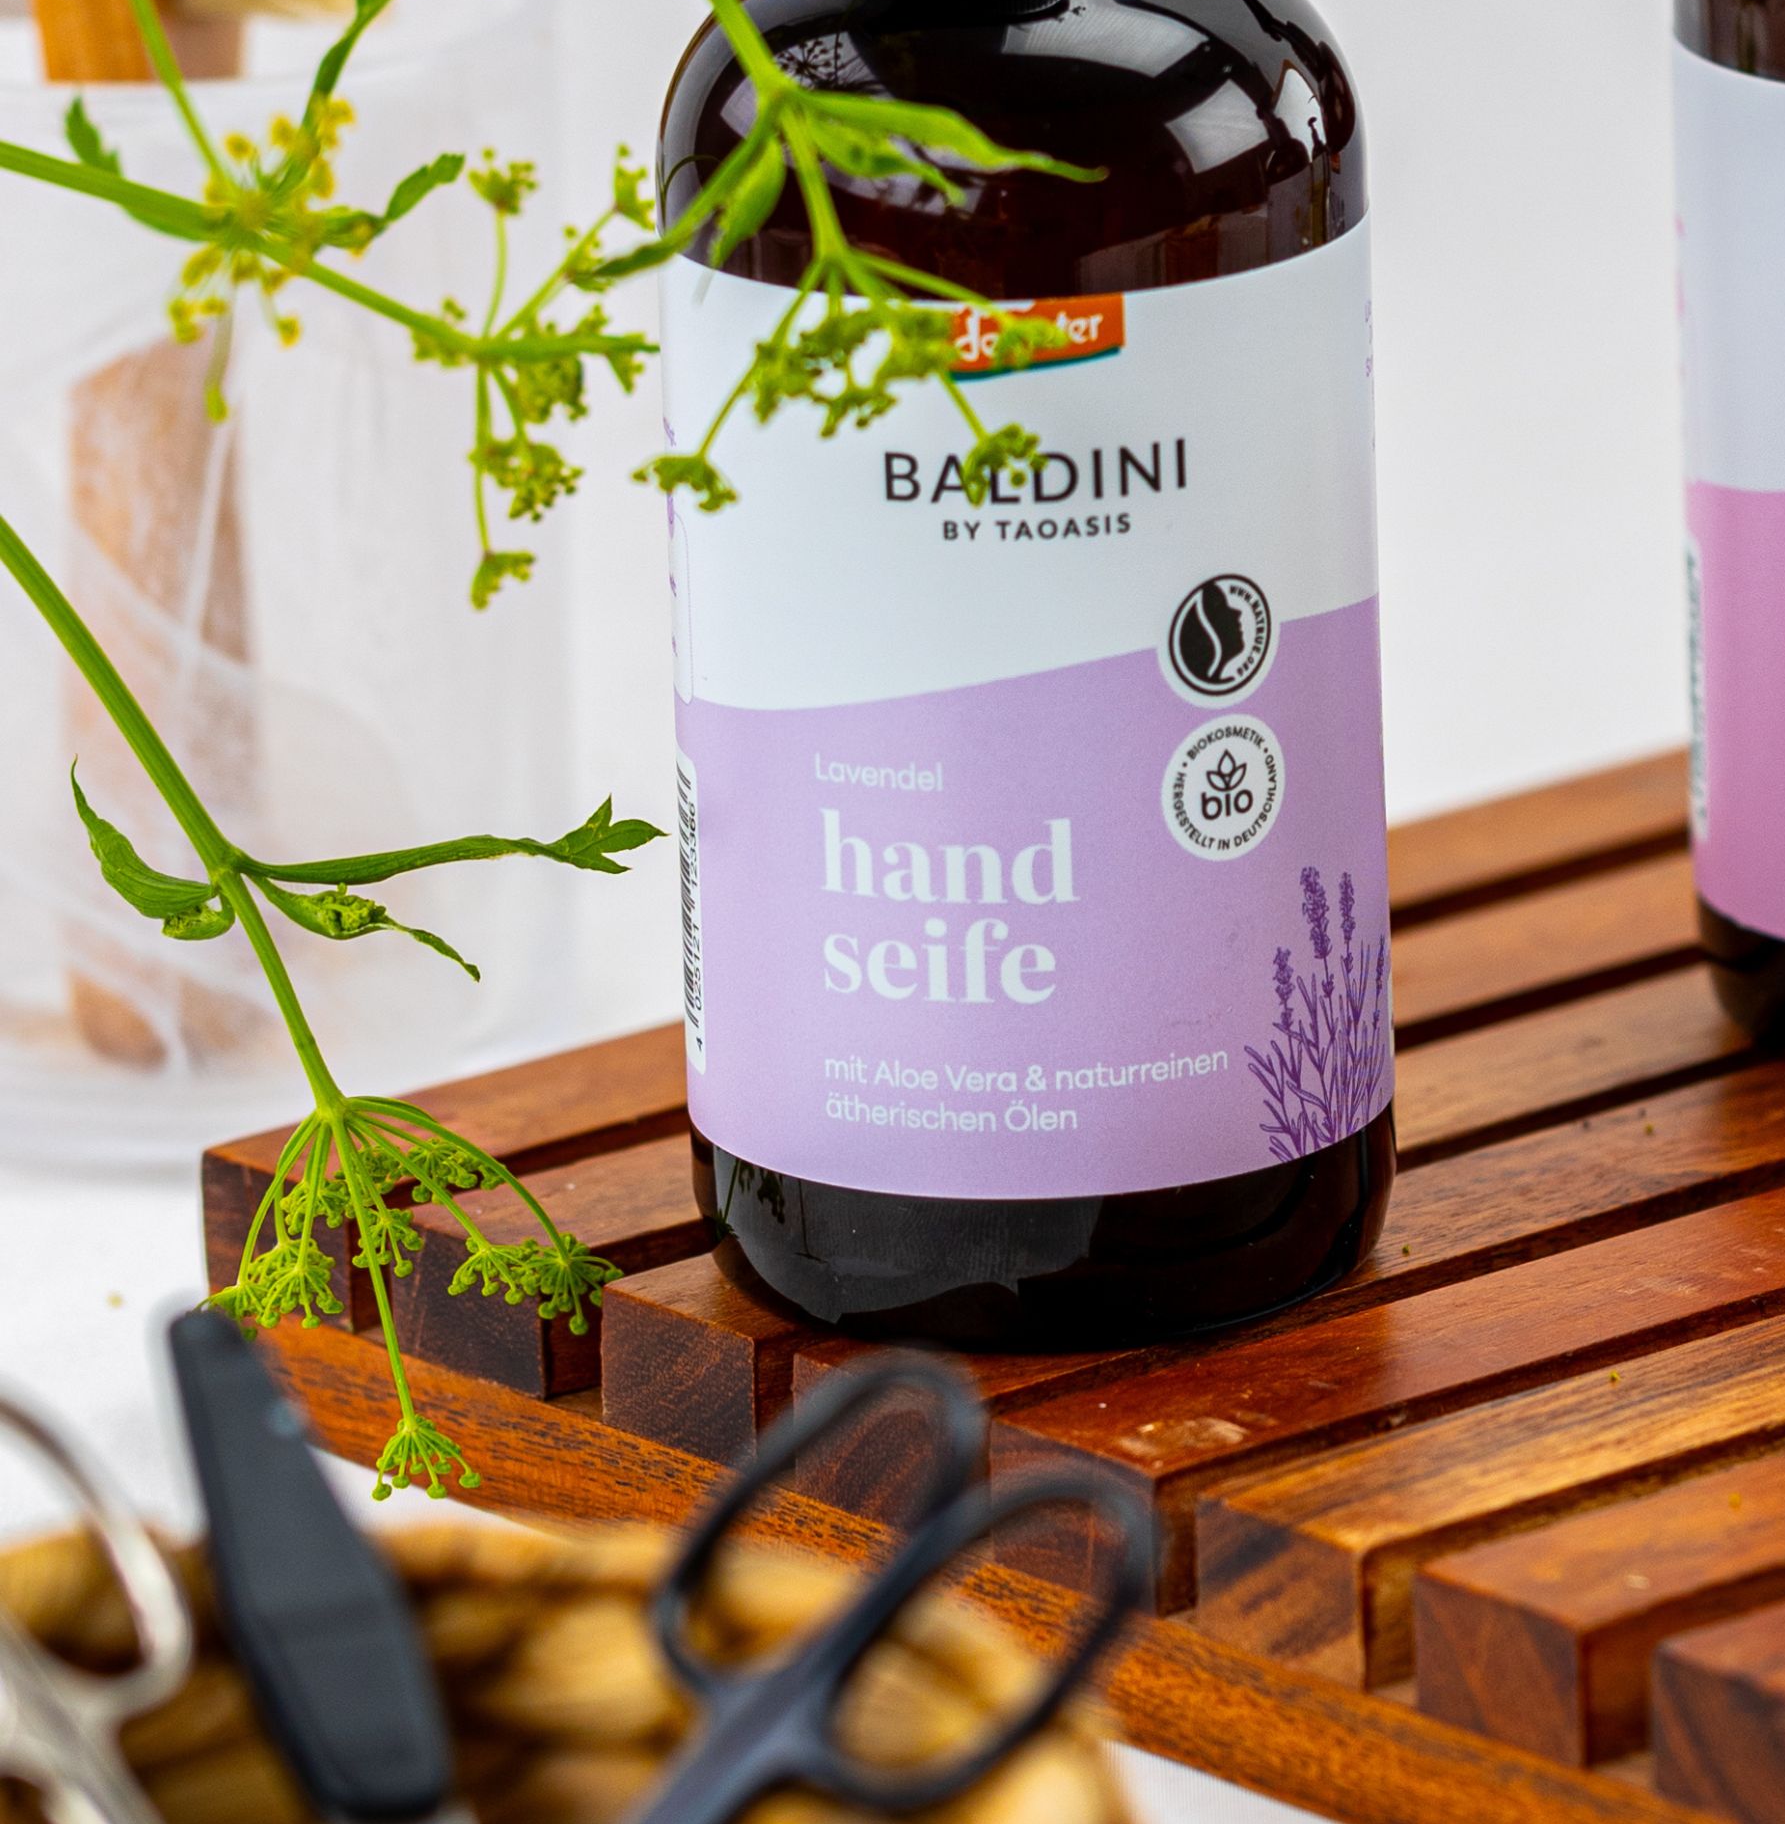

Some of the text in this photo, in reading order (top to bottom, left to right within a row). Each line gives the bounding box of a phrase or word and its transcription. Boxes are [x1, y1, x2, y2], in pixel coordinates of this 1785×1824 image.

[943, 513, 1132, 541] BY TAOASIS
[1187, 725, 1265, 760] BIOKOSMETIK
[814, 752, 944, 792] Lavendel
[1173, 754, 1277, 850] HERGESTELLT IN DEUTSCHLAND
[1201, 789, 1254, 821] bio
[819, 808, 1081, 905] hand
[823, 917, 1056, 1005] seife
[824, 1049, 1229, 1093] mit Aloe Vera & naturreinen
[825, 1092, 1078, 1132] ätherischen Ölen
